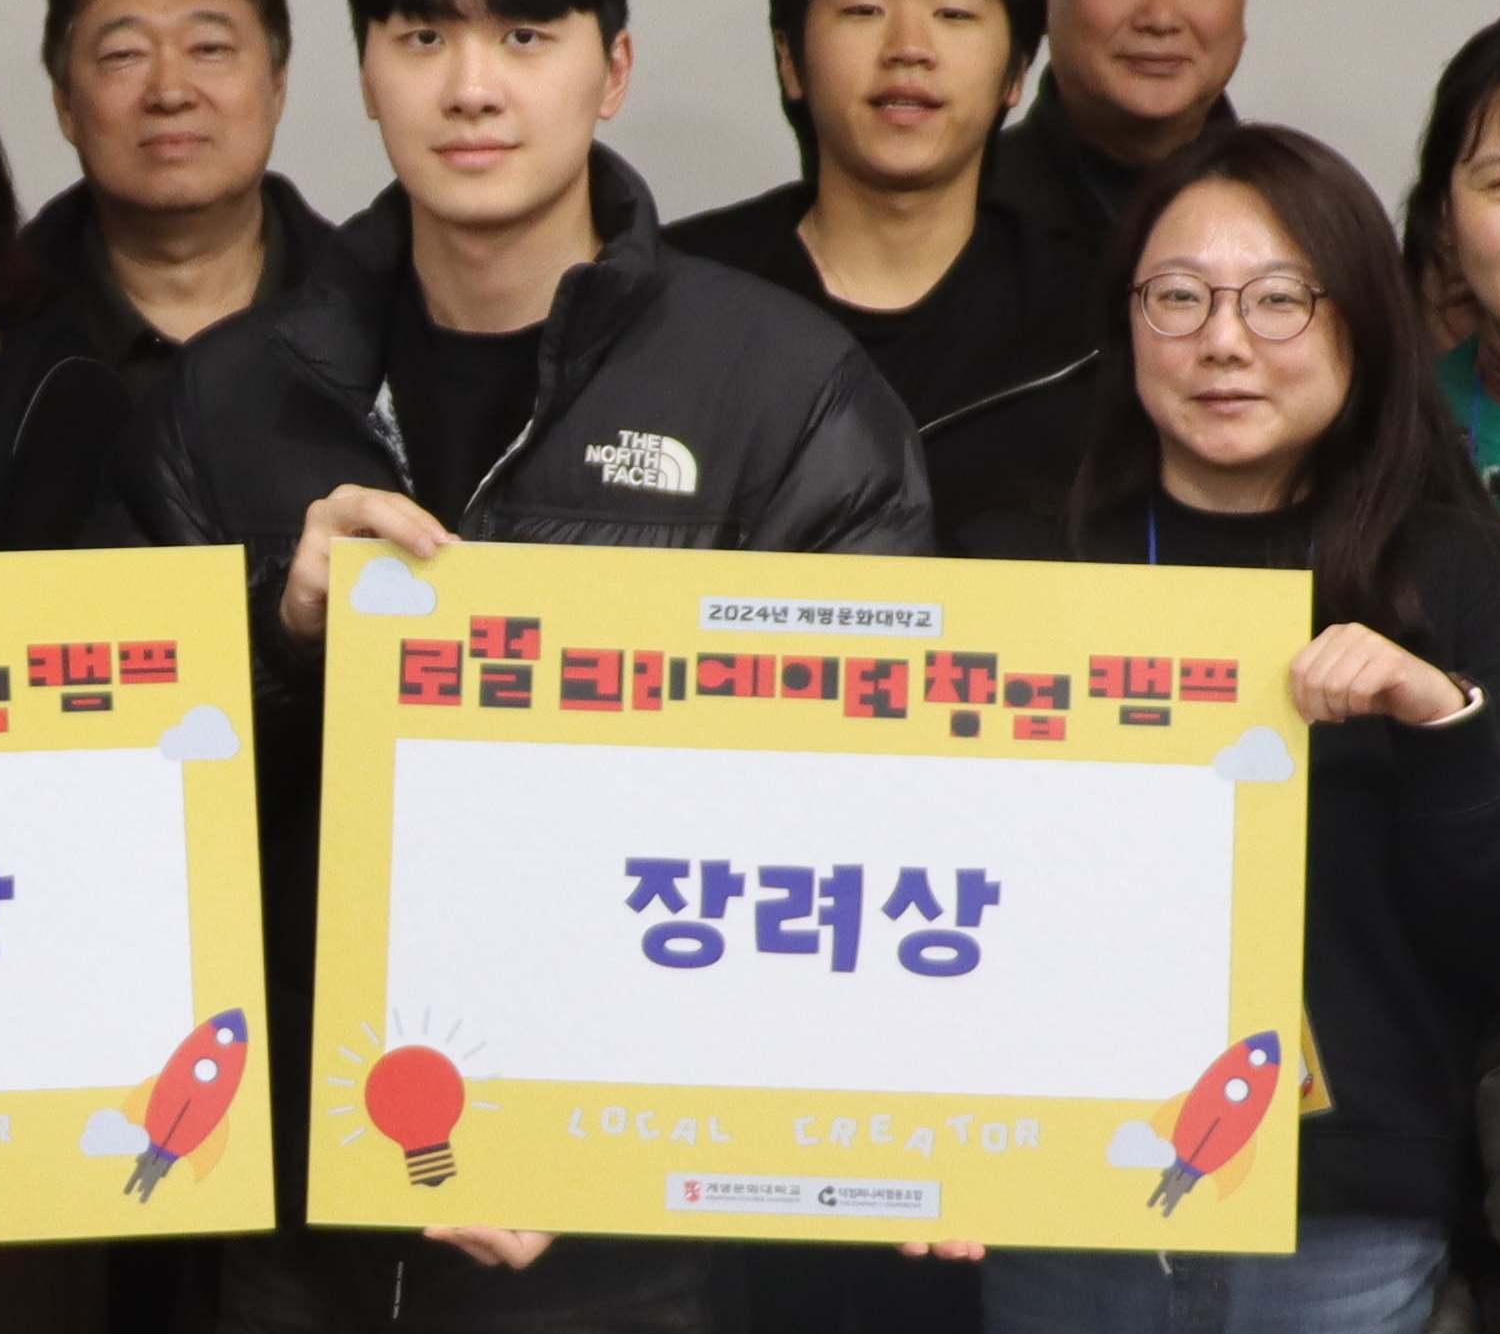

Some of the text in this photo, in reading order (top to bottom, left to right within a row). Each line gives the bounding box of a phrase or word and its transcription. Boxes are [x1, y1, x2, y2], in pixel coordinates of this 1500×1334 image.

[619, 429, 662, 452] THE
[585, 444, 660, 469] NORTH
[602, 463, 658, 486] FACE
[708, 604, 934, 628] 2024년 계명문화대학교
[624, 856, 1002, 978] 장려상
[567, 1105, 1041, 1159] LOCAL CREATOR
